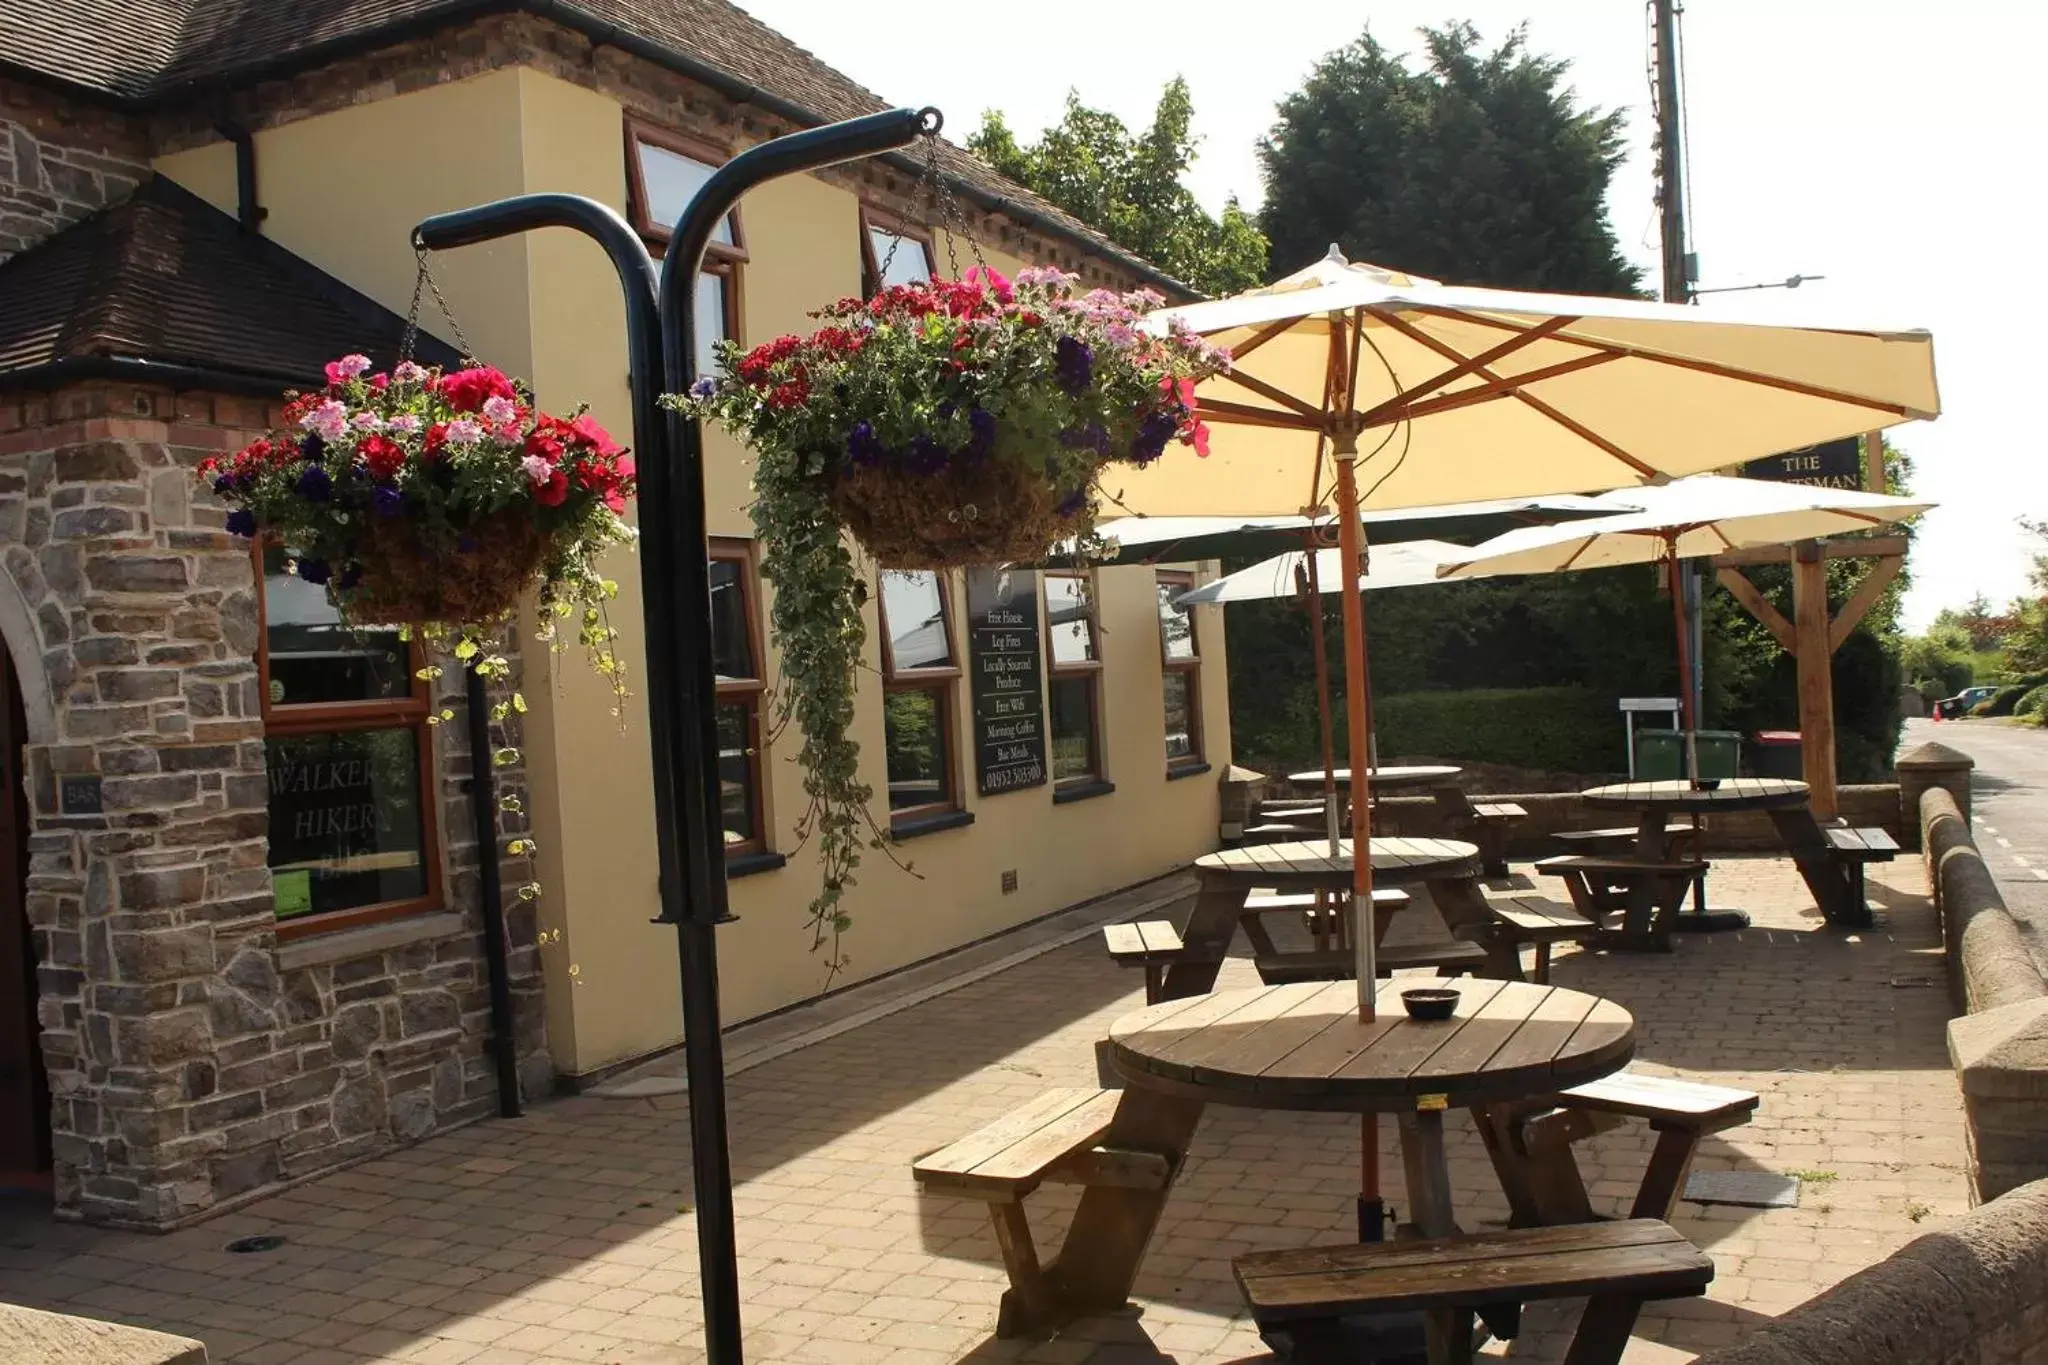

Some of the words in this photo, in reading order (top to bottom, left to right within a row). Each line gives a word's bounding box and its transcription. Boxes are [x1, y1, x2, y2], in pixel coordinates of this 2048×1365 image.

[1781, 456, 1821, 471] THE
[988, 610, 1001, 624] Free
[1003, 610, 1024, 624] House
[992, 633, 1004, 650] Log
[1005, 633, 1021, 648] Fires
[984, 657, 1006, 674] Locally
[1007, 656, 1032, 671] Sourced
[996, 674, 1022, 688] Produce
[996, 699, 1009, 713] Free
[987, 724, 1015, 739] Morning
[1016, 720, 1036, 735] Coffee
[1010, 743, 1029, 759] Meals
[67, 784, 98, 804] BAR
